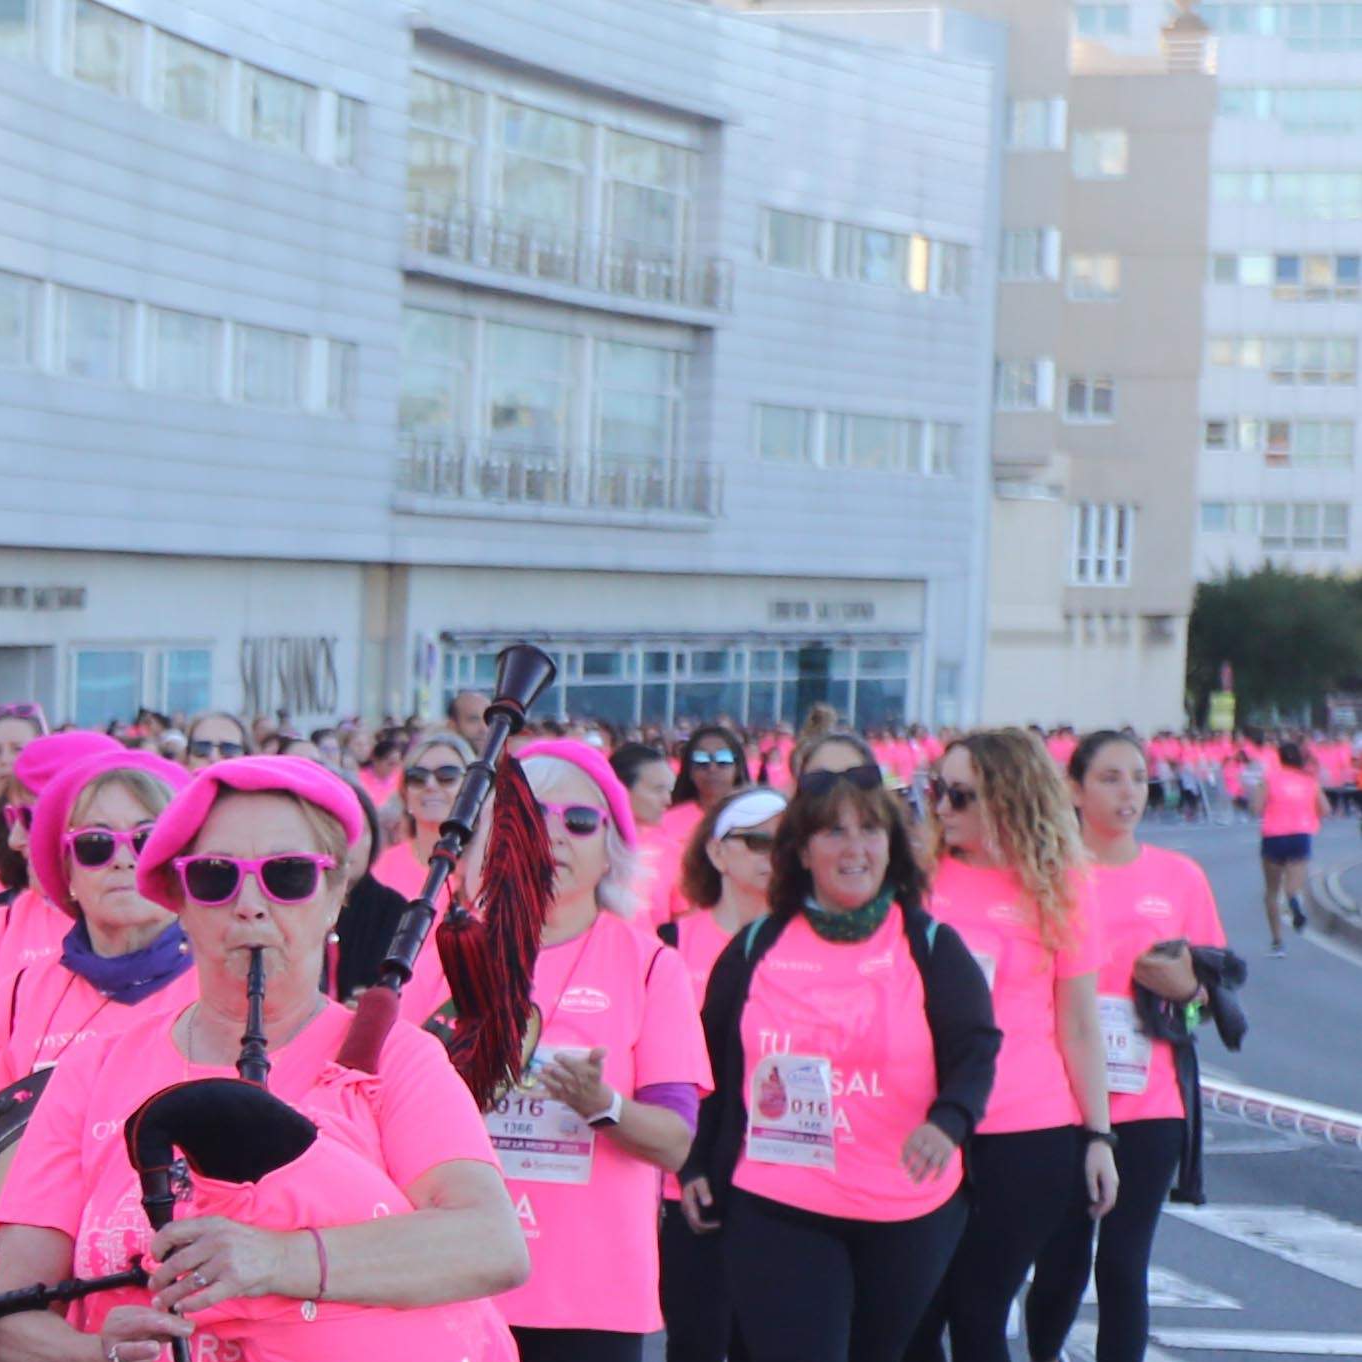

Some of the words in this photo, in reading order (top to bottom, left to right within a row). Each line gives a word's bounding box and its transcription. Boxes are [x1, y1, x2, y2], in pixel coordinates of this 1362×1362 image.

[759, 1031, 792, 1055] TU
[1106, 1034, 1127, 1049] 16
[830, 1071, 884, 1096] SAL
